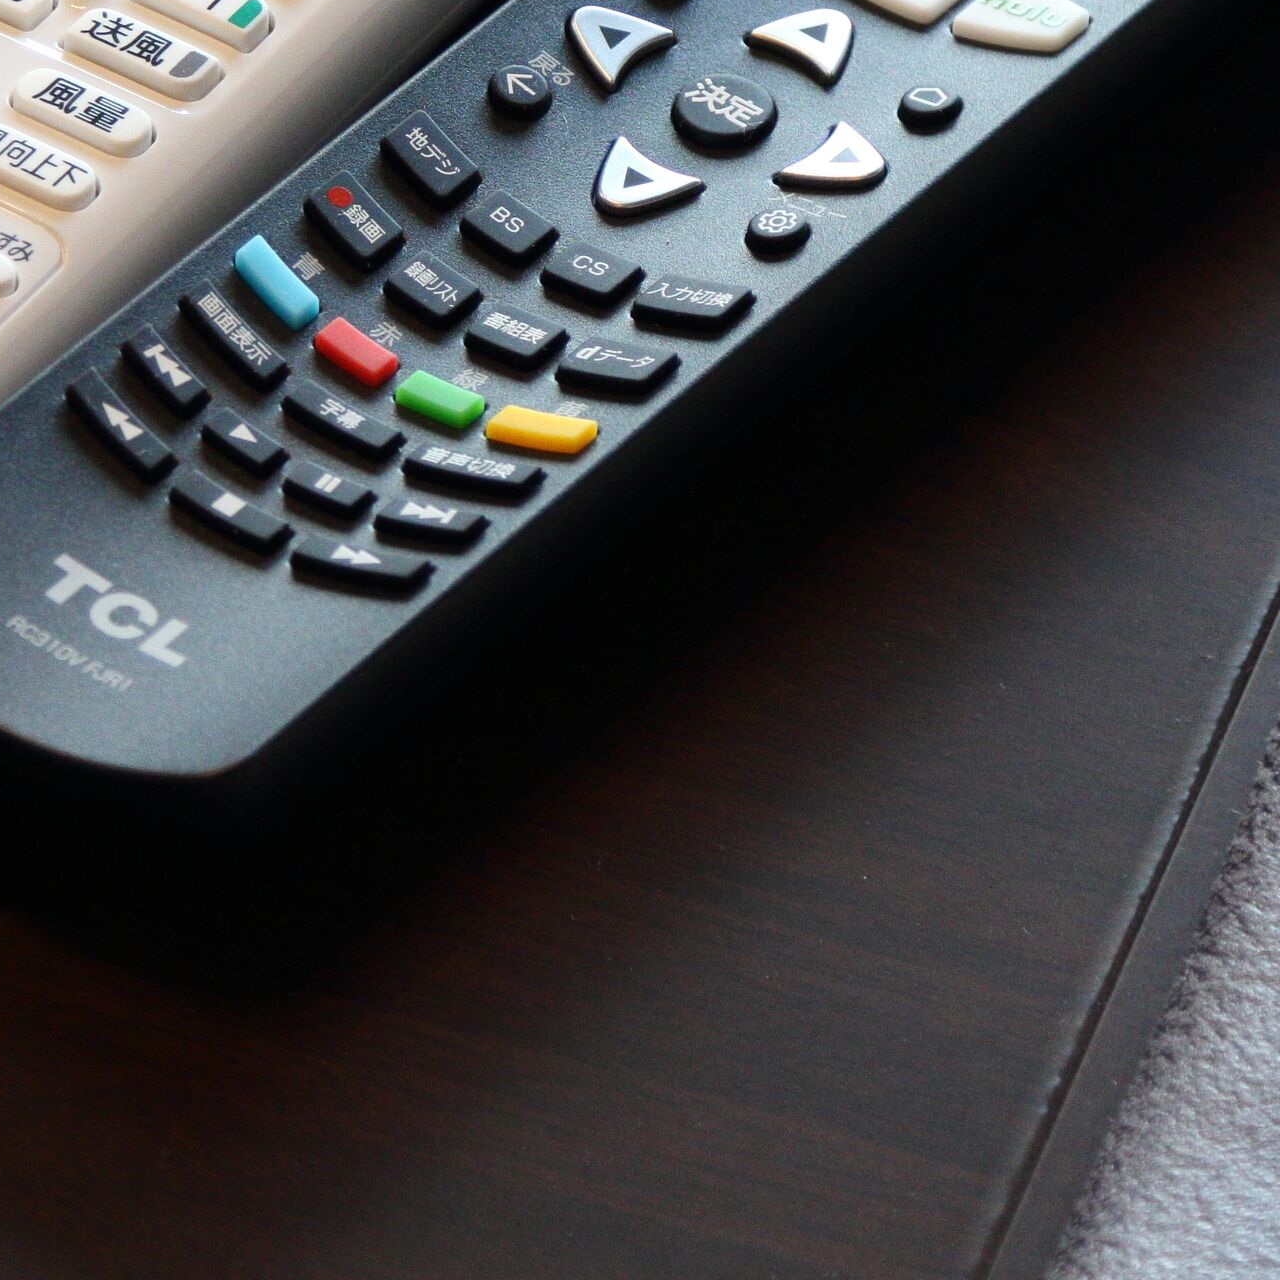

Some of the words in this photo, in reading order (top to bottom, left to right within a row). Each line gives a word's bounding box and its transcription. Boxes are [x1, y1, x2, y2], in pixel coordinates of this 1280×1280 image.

[81, 10, 174, 67] 送風
[528, 50, 572, 87] 戻る
[32, 77, 129, 133] 風量
[684, 76, 765, 128] 決定
[405, 126, 460, 176] 地デジ
[489, 202, 524, 233] BS
[767, 191, 847, 218] メニュー
[342, 204, 386, 244] 録画
[404, 261, 462, 303] 録画リスト
[572, 255, 611, 277] CS
[647, 280, 733, 308] 入力切換
[196, 290, 273, 363] 画面表示
[372, 321, 403, 347] 赤
[483, 312, 547, 345] 番組表
[575, 346, 658, 370] dデータ
[422, 447, 516, 479] 音声切換
[44, 553, 189, 668] TCL
